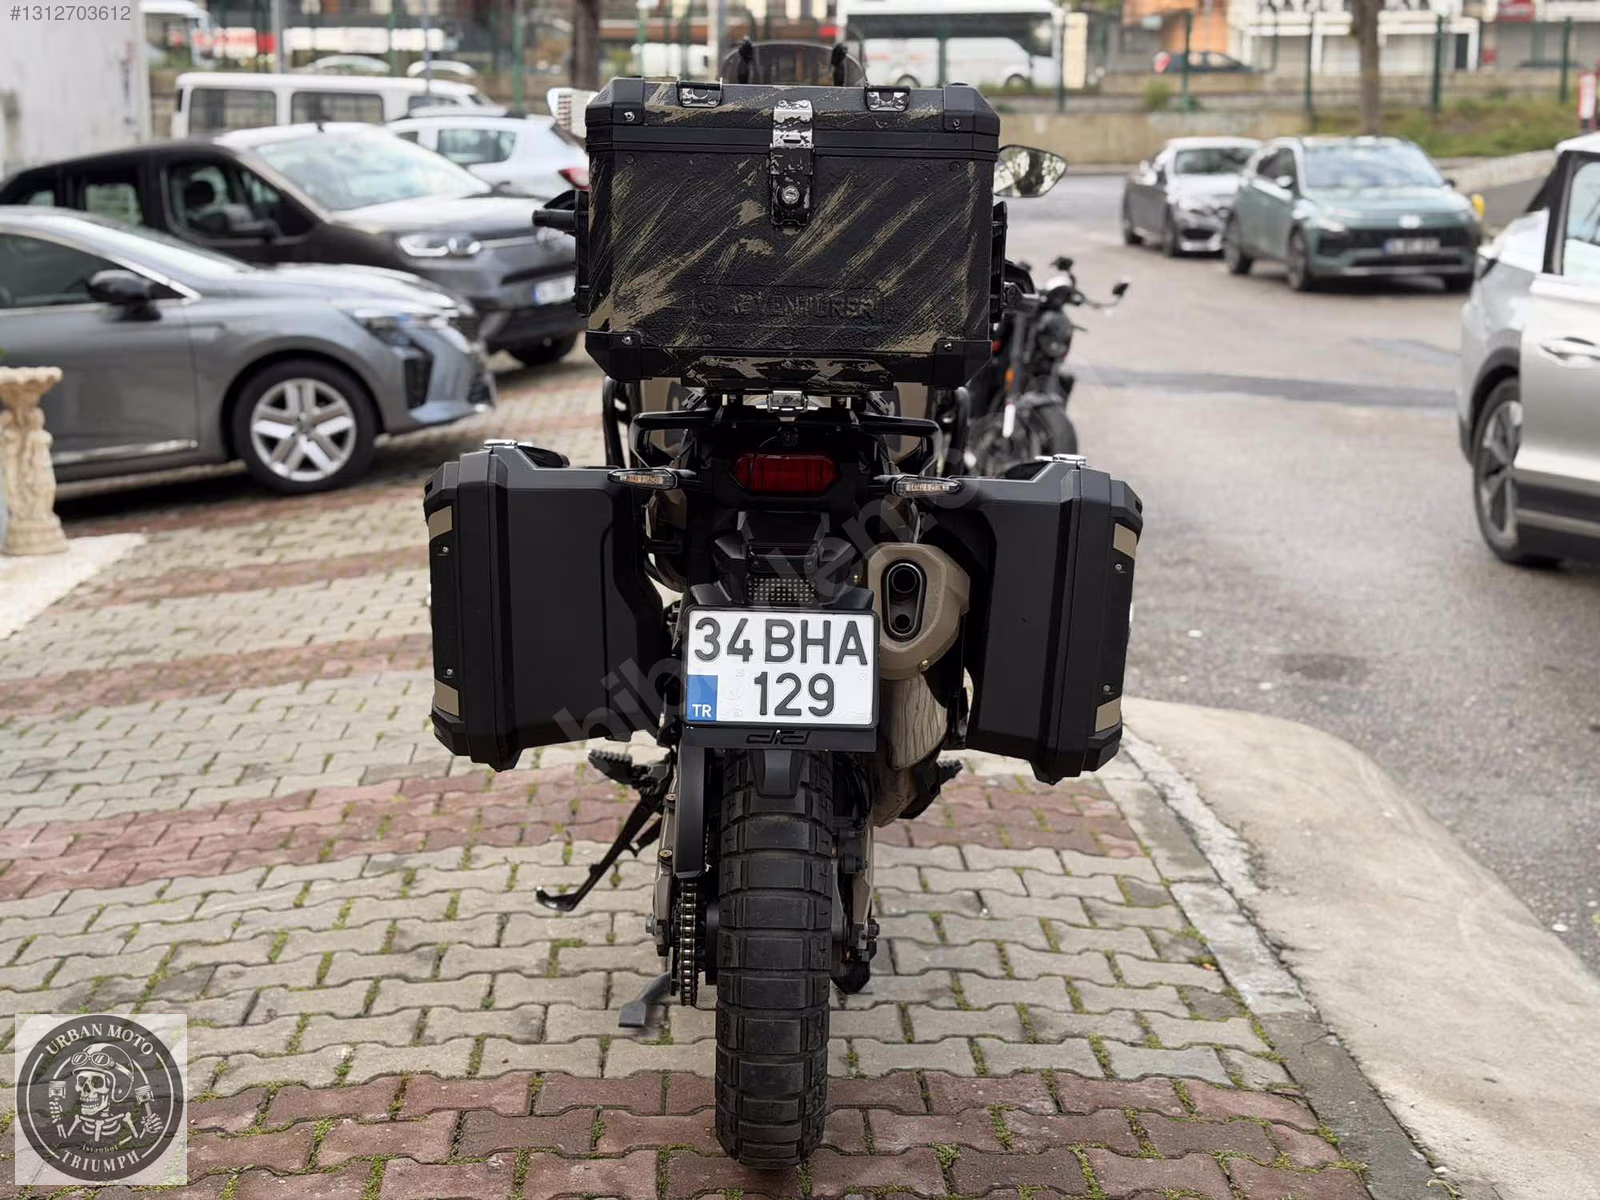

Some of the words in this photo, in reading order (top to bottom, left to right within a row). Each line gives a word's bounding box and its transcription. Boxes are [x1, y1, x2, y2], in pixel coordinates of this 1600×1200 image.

[694, 617, 753, 662] 34
[764, 618, 868, 666] BHA
[692, 704, 712, 718] TR
[754, 671, 835, 717] 129
